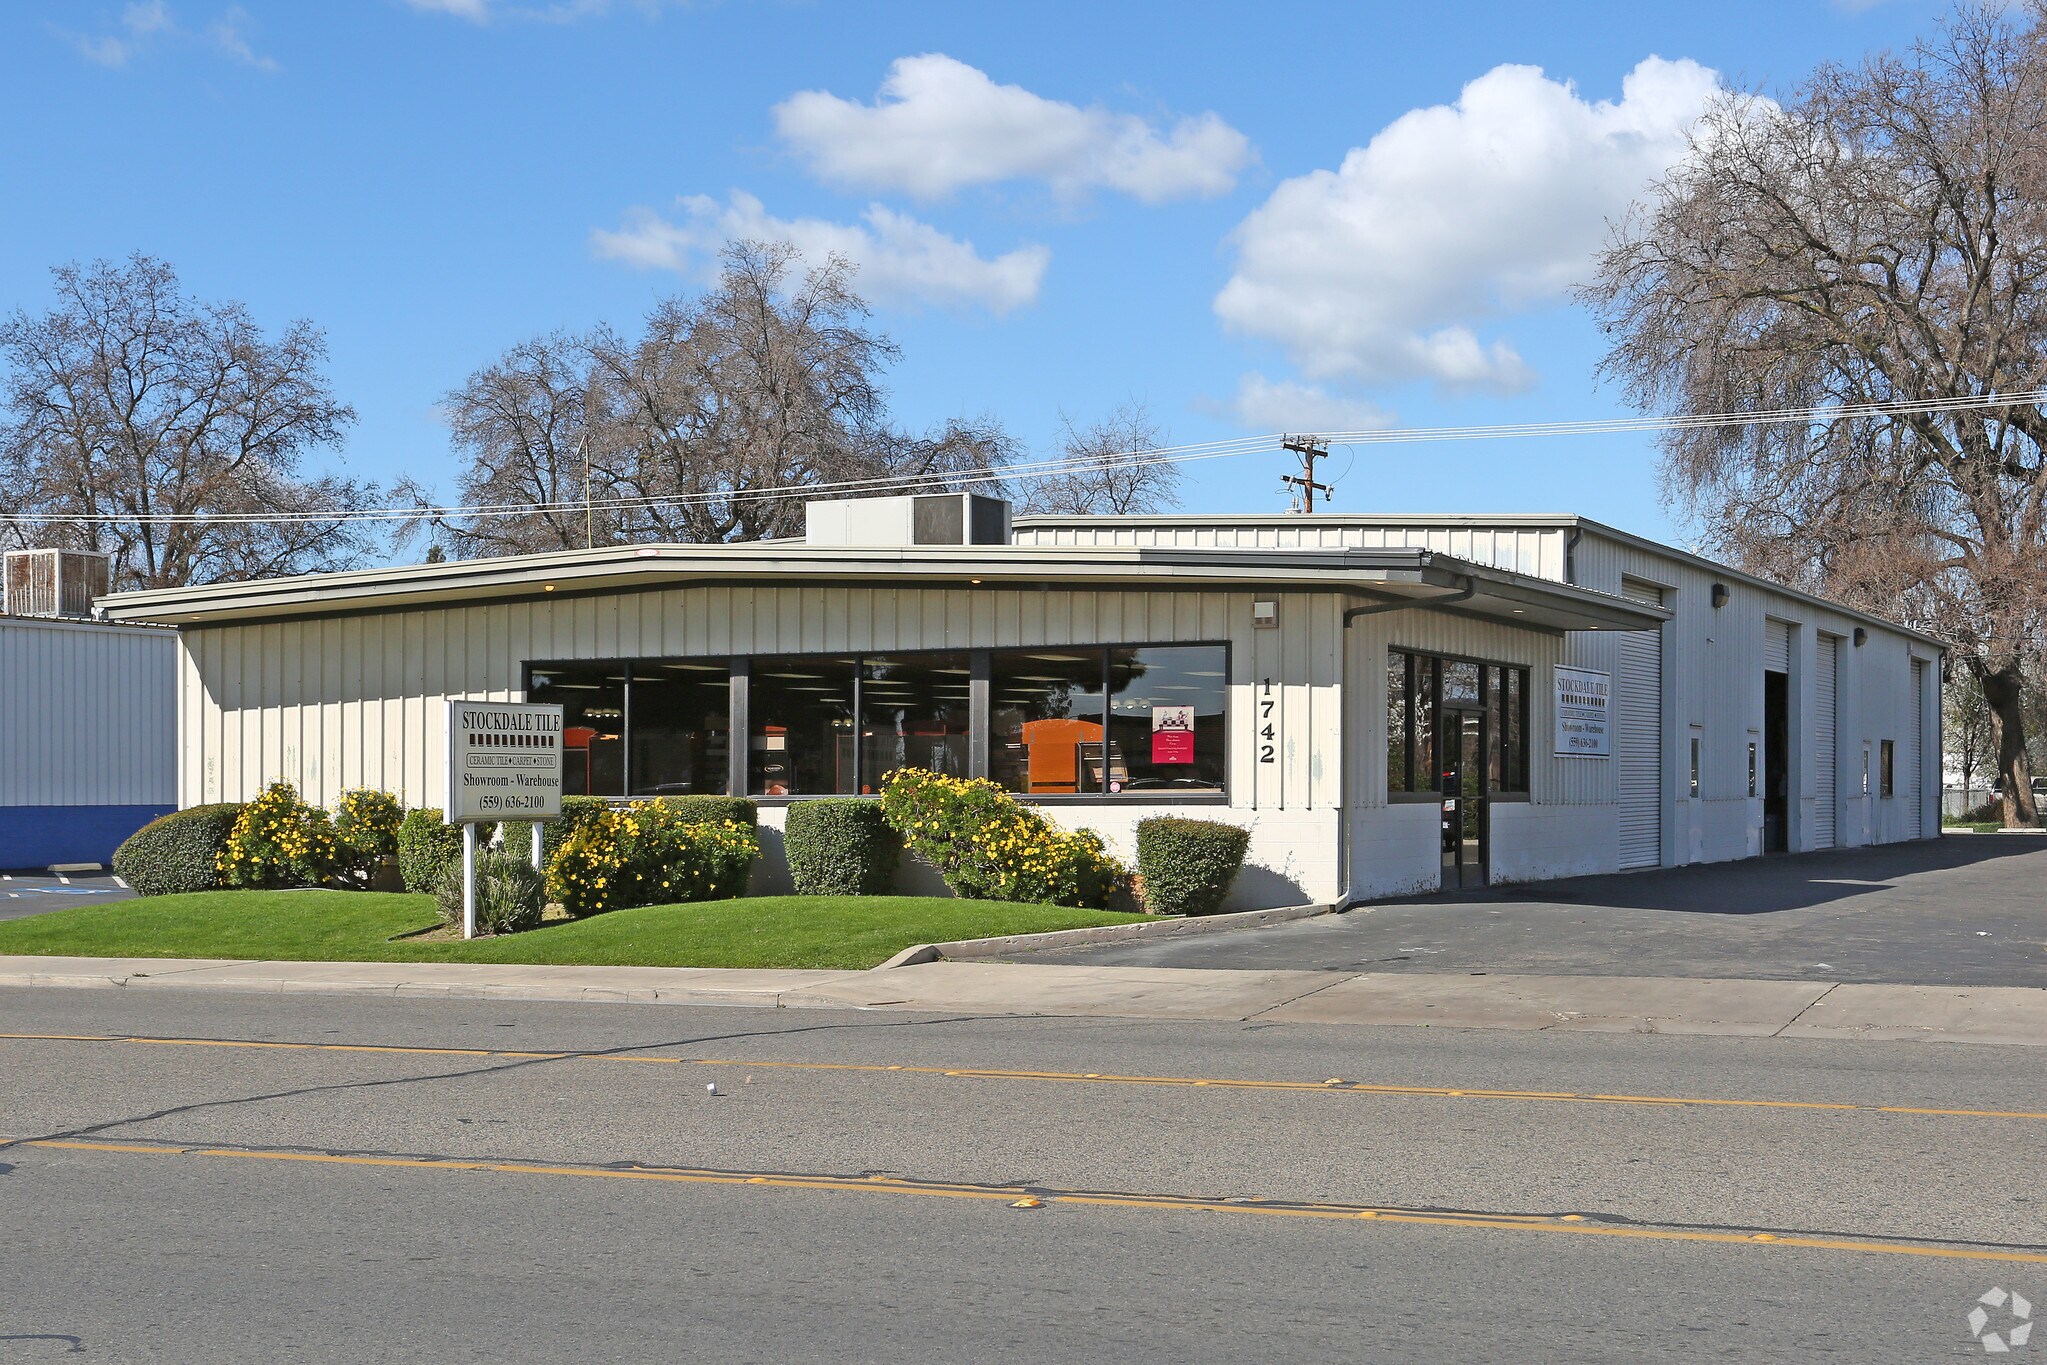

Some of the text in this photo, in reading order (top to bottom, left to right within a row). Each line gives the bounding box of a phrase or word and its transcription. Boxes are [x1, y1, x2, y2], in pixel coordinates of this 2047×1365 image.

[1557, 677, 1608, 696] STOCKDALE TILE
[462, 711, 560, 732] STOCKDALE TILE
[1260, 677, 1275, 763] 1742
[469, 755, 554, 766] CERAMIC TILE CARPET STONE
[463, 773, 509, 787] Showroom
[516, 773, 560, 787] Warehouse
[479, 795, 545, 811] (559) 636-2100
